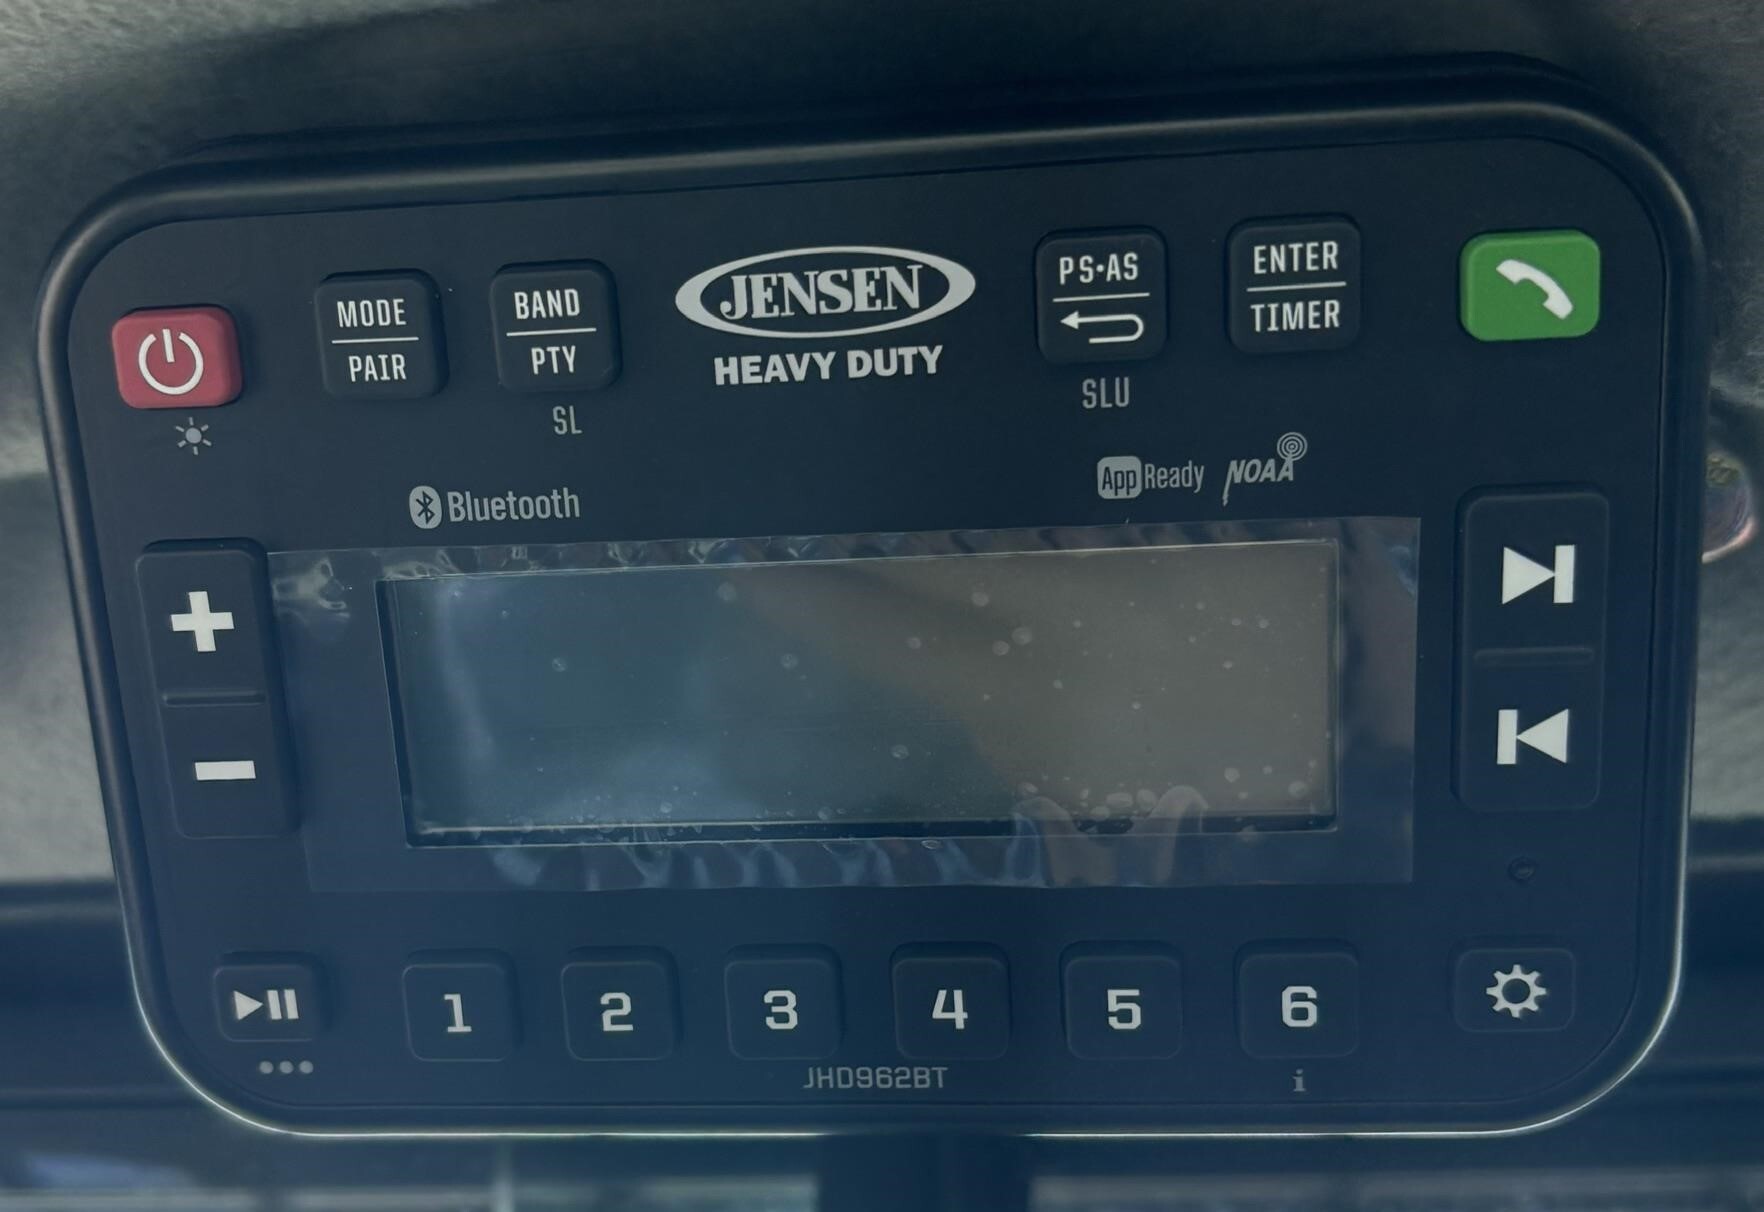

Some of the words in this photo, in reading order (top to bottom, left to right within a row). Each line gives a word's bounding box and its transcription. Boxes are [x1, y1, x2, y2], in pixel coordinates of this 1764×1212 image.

[1253, 240, 1338, 275] ENTER
[514, 288, 580, 320] BAND
[719, 264, 923, 320] JENSEN
[336, 298, 407, 328] MODE
[1250, 299, 1340, 332] TIMER
[348, 353, 407, 382] PAIR
[531, 345, 576, 375] PTY
[713, 351, 837, 386] HEAVY
[846, 344, 943, 379] DUTY
[1082, 376, 1130, 409] SLU
[552, 405, 583, 435] SL
[1222, 456, 1295, 507] NOAA
[447, 487, 580, 522] Bluetooth
[443, 993, 472, 1033] 1
[600, 992, 634, 1032] 2
[763, 989, 798, 1030] 3
[932, 989, 969, 1030] 4
[1107, 989, 1142, 1030] 5
[1281, 985, 1318, 1028] 6
[802, 1066, 948, 1089] JHD962BT
